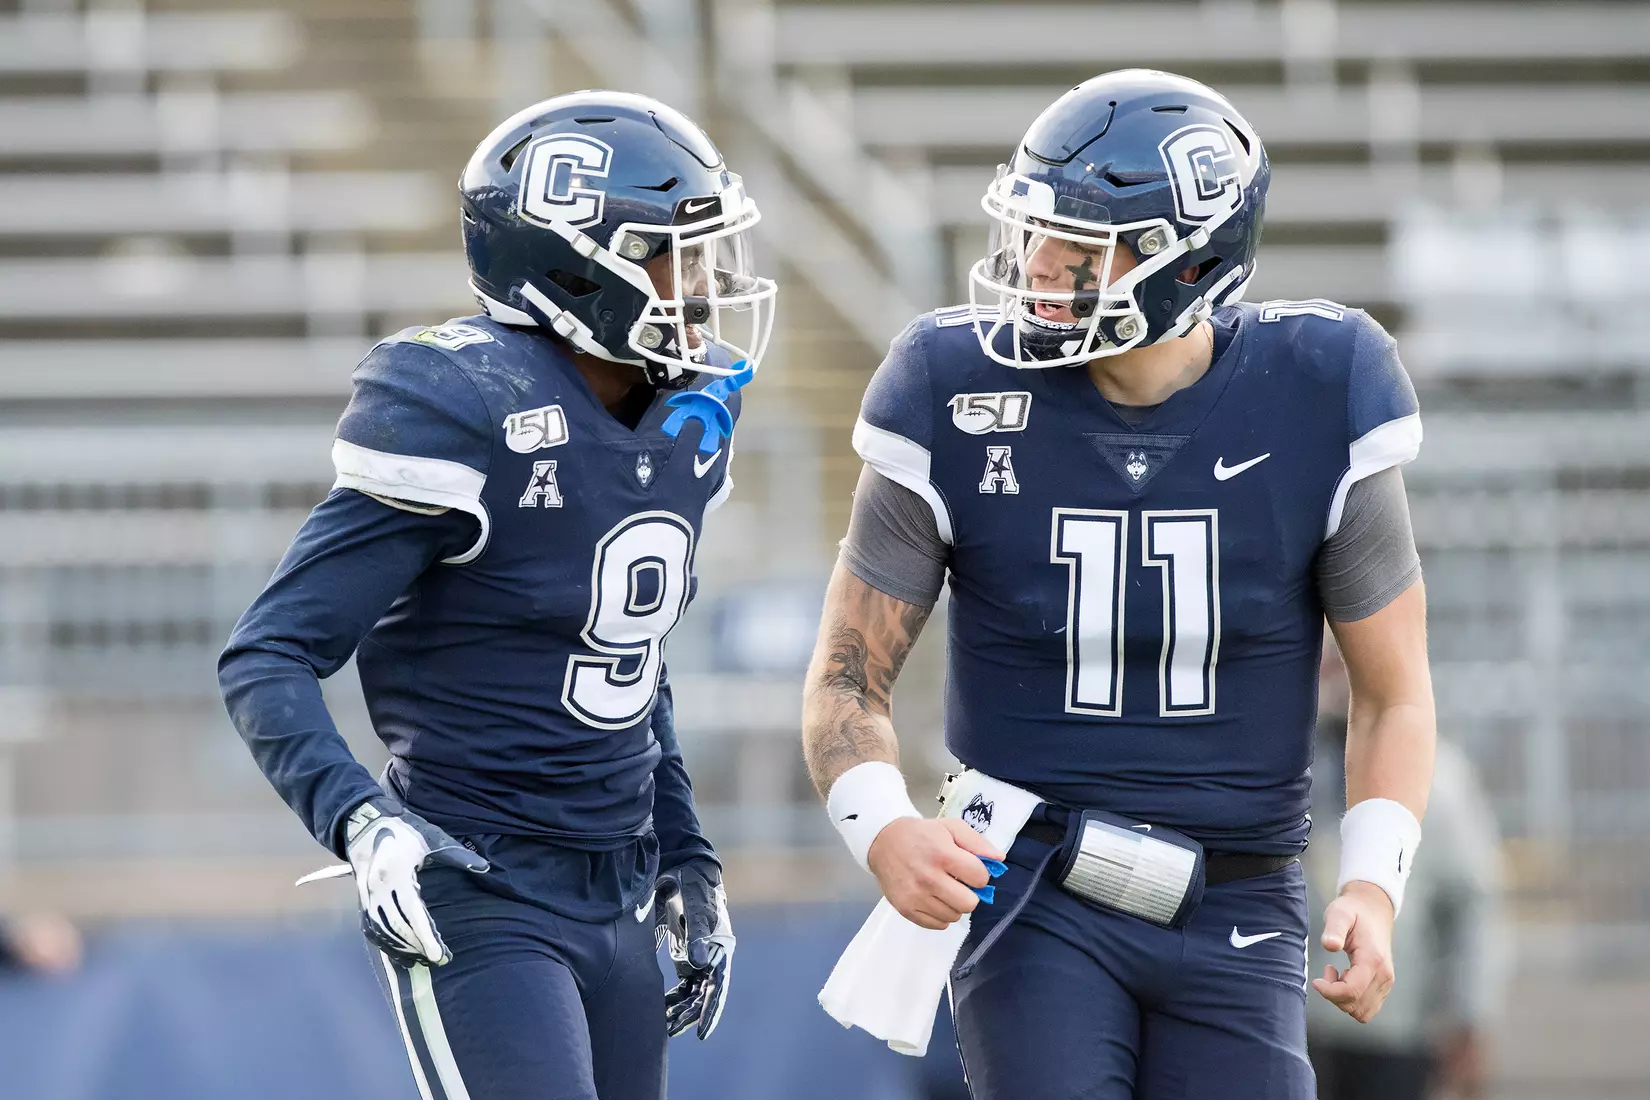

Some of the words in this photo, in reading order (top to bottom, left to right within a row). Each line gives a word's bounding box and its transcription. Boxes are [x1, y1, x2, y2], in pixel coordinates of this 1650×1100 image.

[517, 133, 614, 230] C
[1158, 124, 1244, 227] C
[504, 405, 568, 453] 150
[949, 393, 1031, 434] 150
[519, 460, 563, 508] A
[979, 446, 1020, 494] A
[561, 510, 694, 731] 9
[1050, 507, 1221, 717] 11
